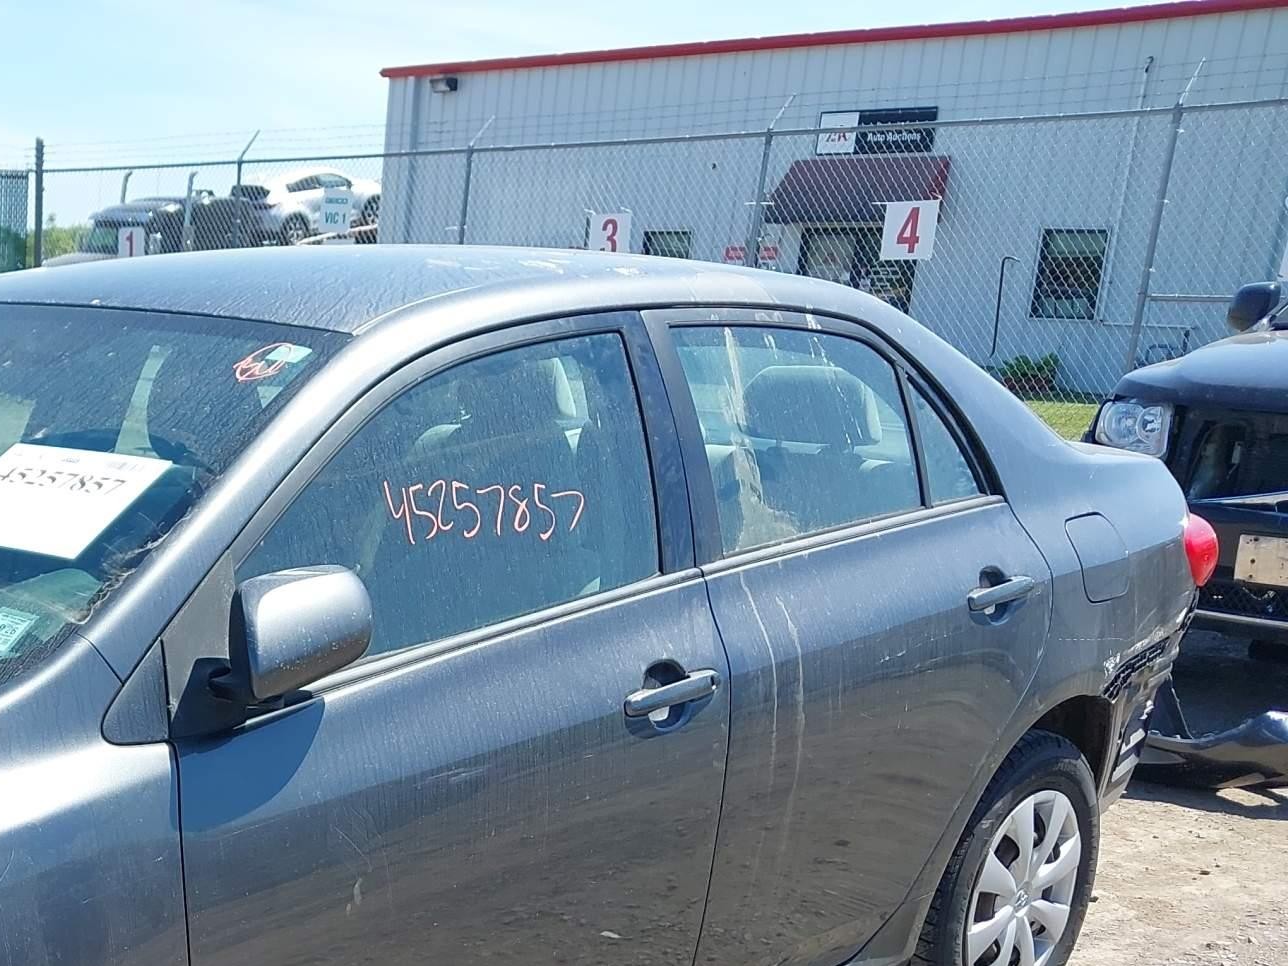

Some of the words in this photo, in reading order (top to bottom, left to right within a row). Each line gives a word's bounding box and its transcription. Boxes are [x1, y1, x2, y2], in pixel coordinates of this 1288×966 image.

[325, 211, 339, 224] VIC
[896, 206, 920, 253] 4
[126, 230, 133, 257] 1
[602, 218, 617, 252] 3
[383, 480, 585, 544] 45257857
